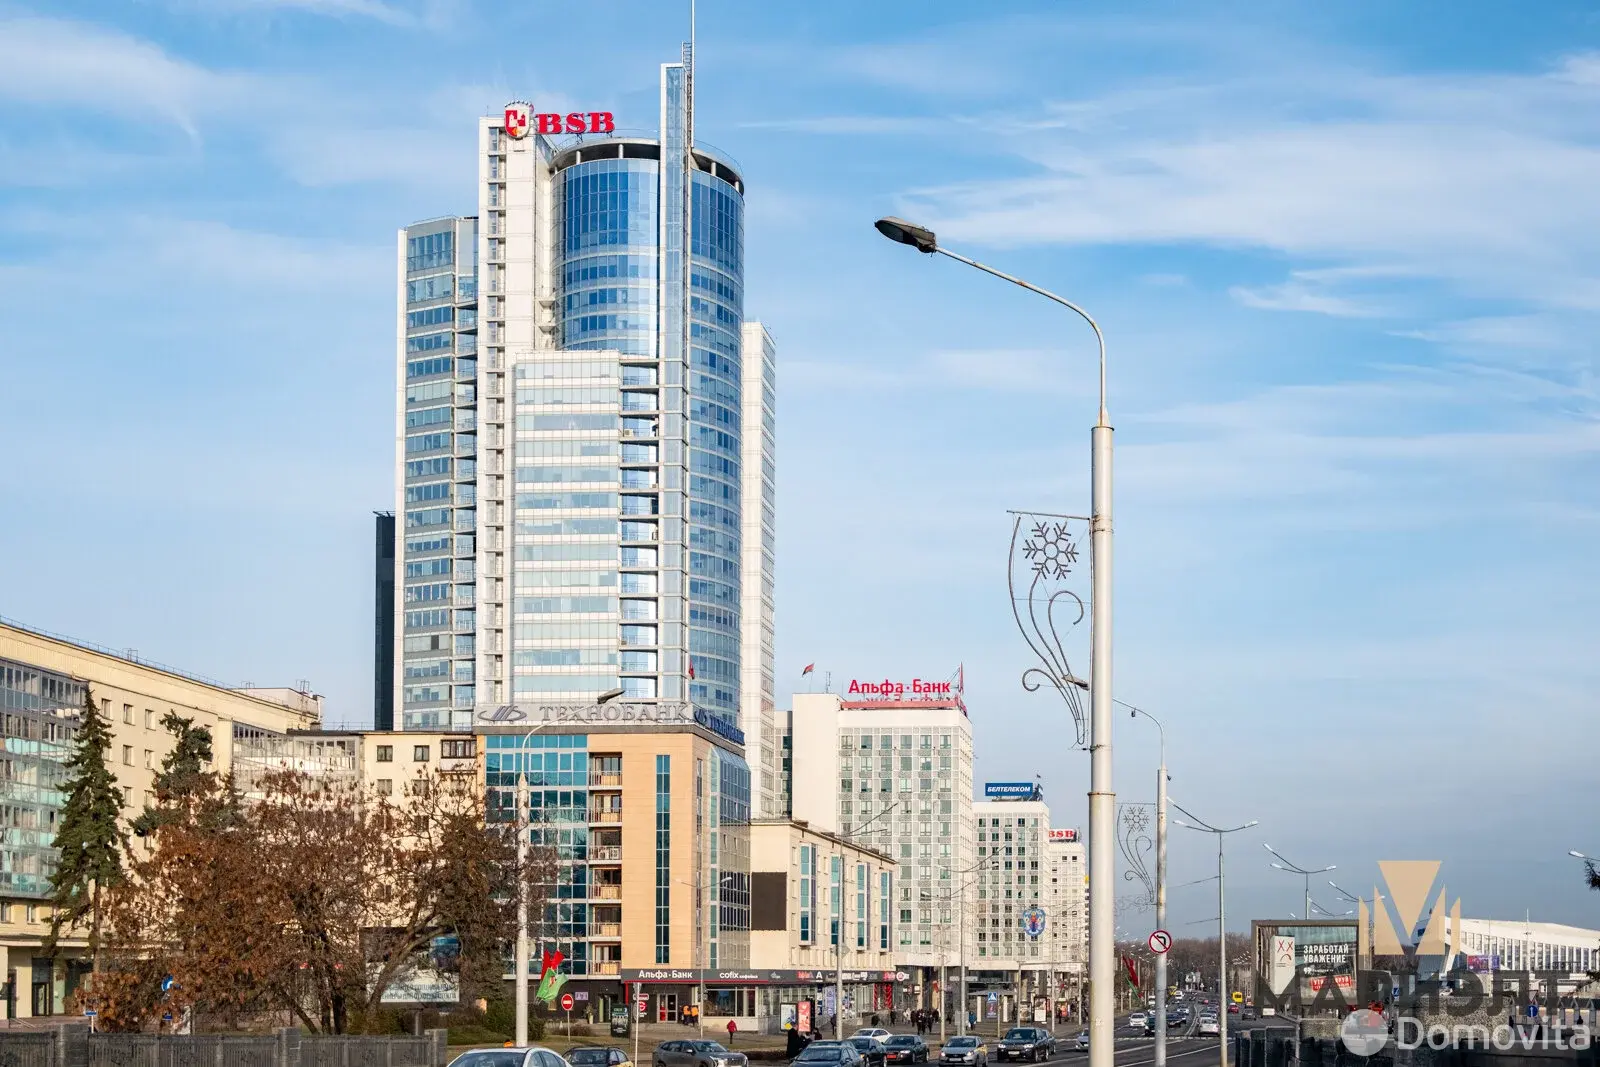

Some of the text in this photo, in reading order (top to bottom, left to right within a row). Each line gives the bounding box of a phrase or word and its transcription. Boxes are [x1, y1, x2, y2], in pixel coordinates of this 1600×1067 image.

[535, 112, 615, 134] BSB
[539, 703, 690, 722] ТЕХНОБАНК
[1303, 944, 1349, 954] ЗАРАБОТАЙ
[1303, 954, 1346, 963] УВАЖЕНИЕ
[719, 971, 739, 979] cofix
